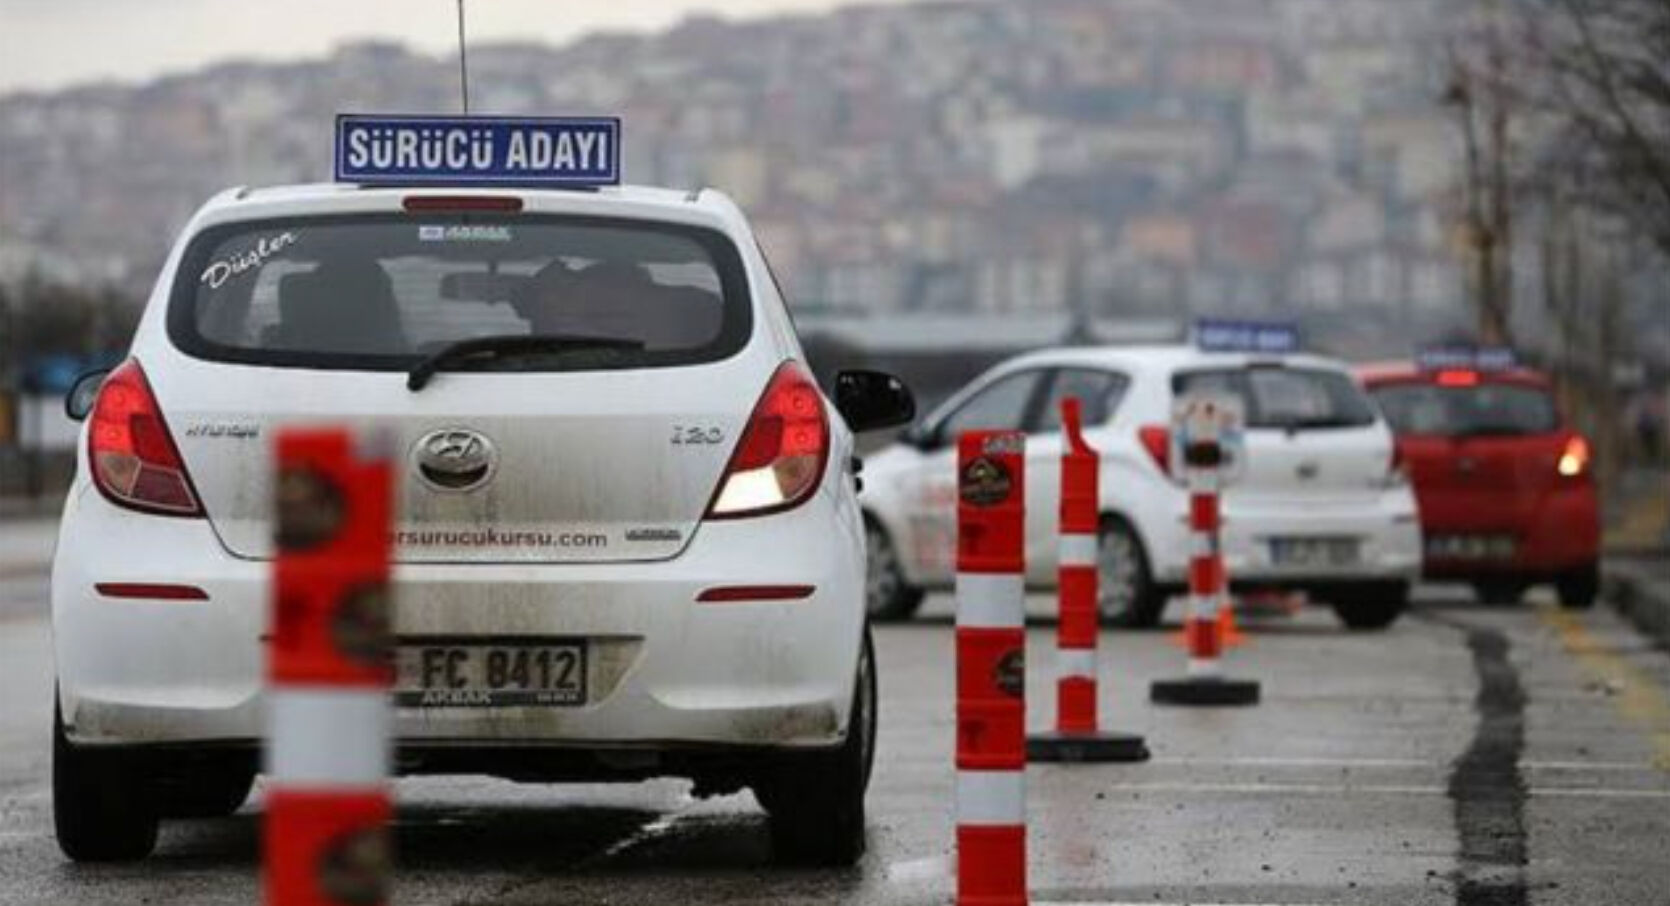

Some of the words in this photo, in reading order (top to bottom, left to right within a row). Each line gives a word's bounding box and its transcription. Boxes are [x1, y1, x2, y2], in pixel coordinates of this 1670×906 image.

[349, 128, 493, 170] SÜRÜCÜ
[505, 131, 606, 170] ADAYI
[200, 231, 295, 289] Düşler
[422, 649, 469, 690] FC
[487, 649, 577, 690] 8412
